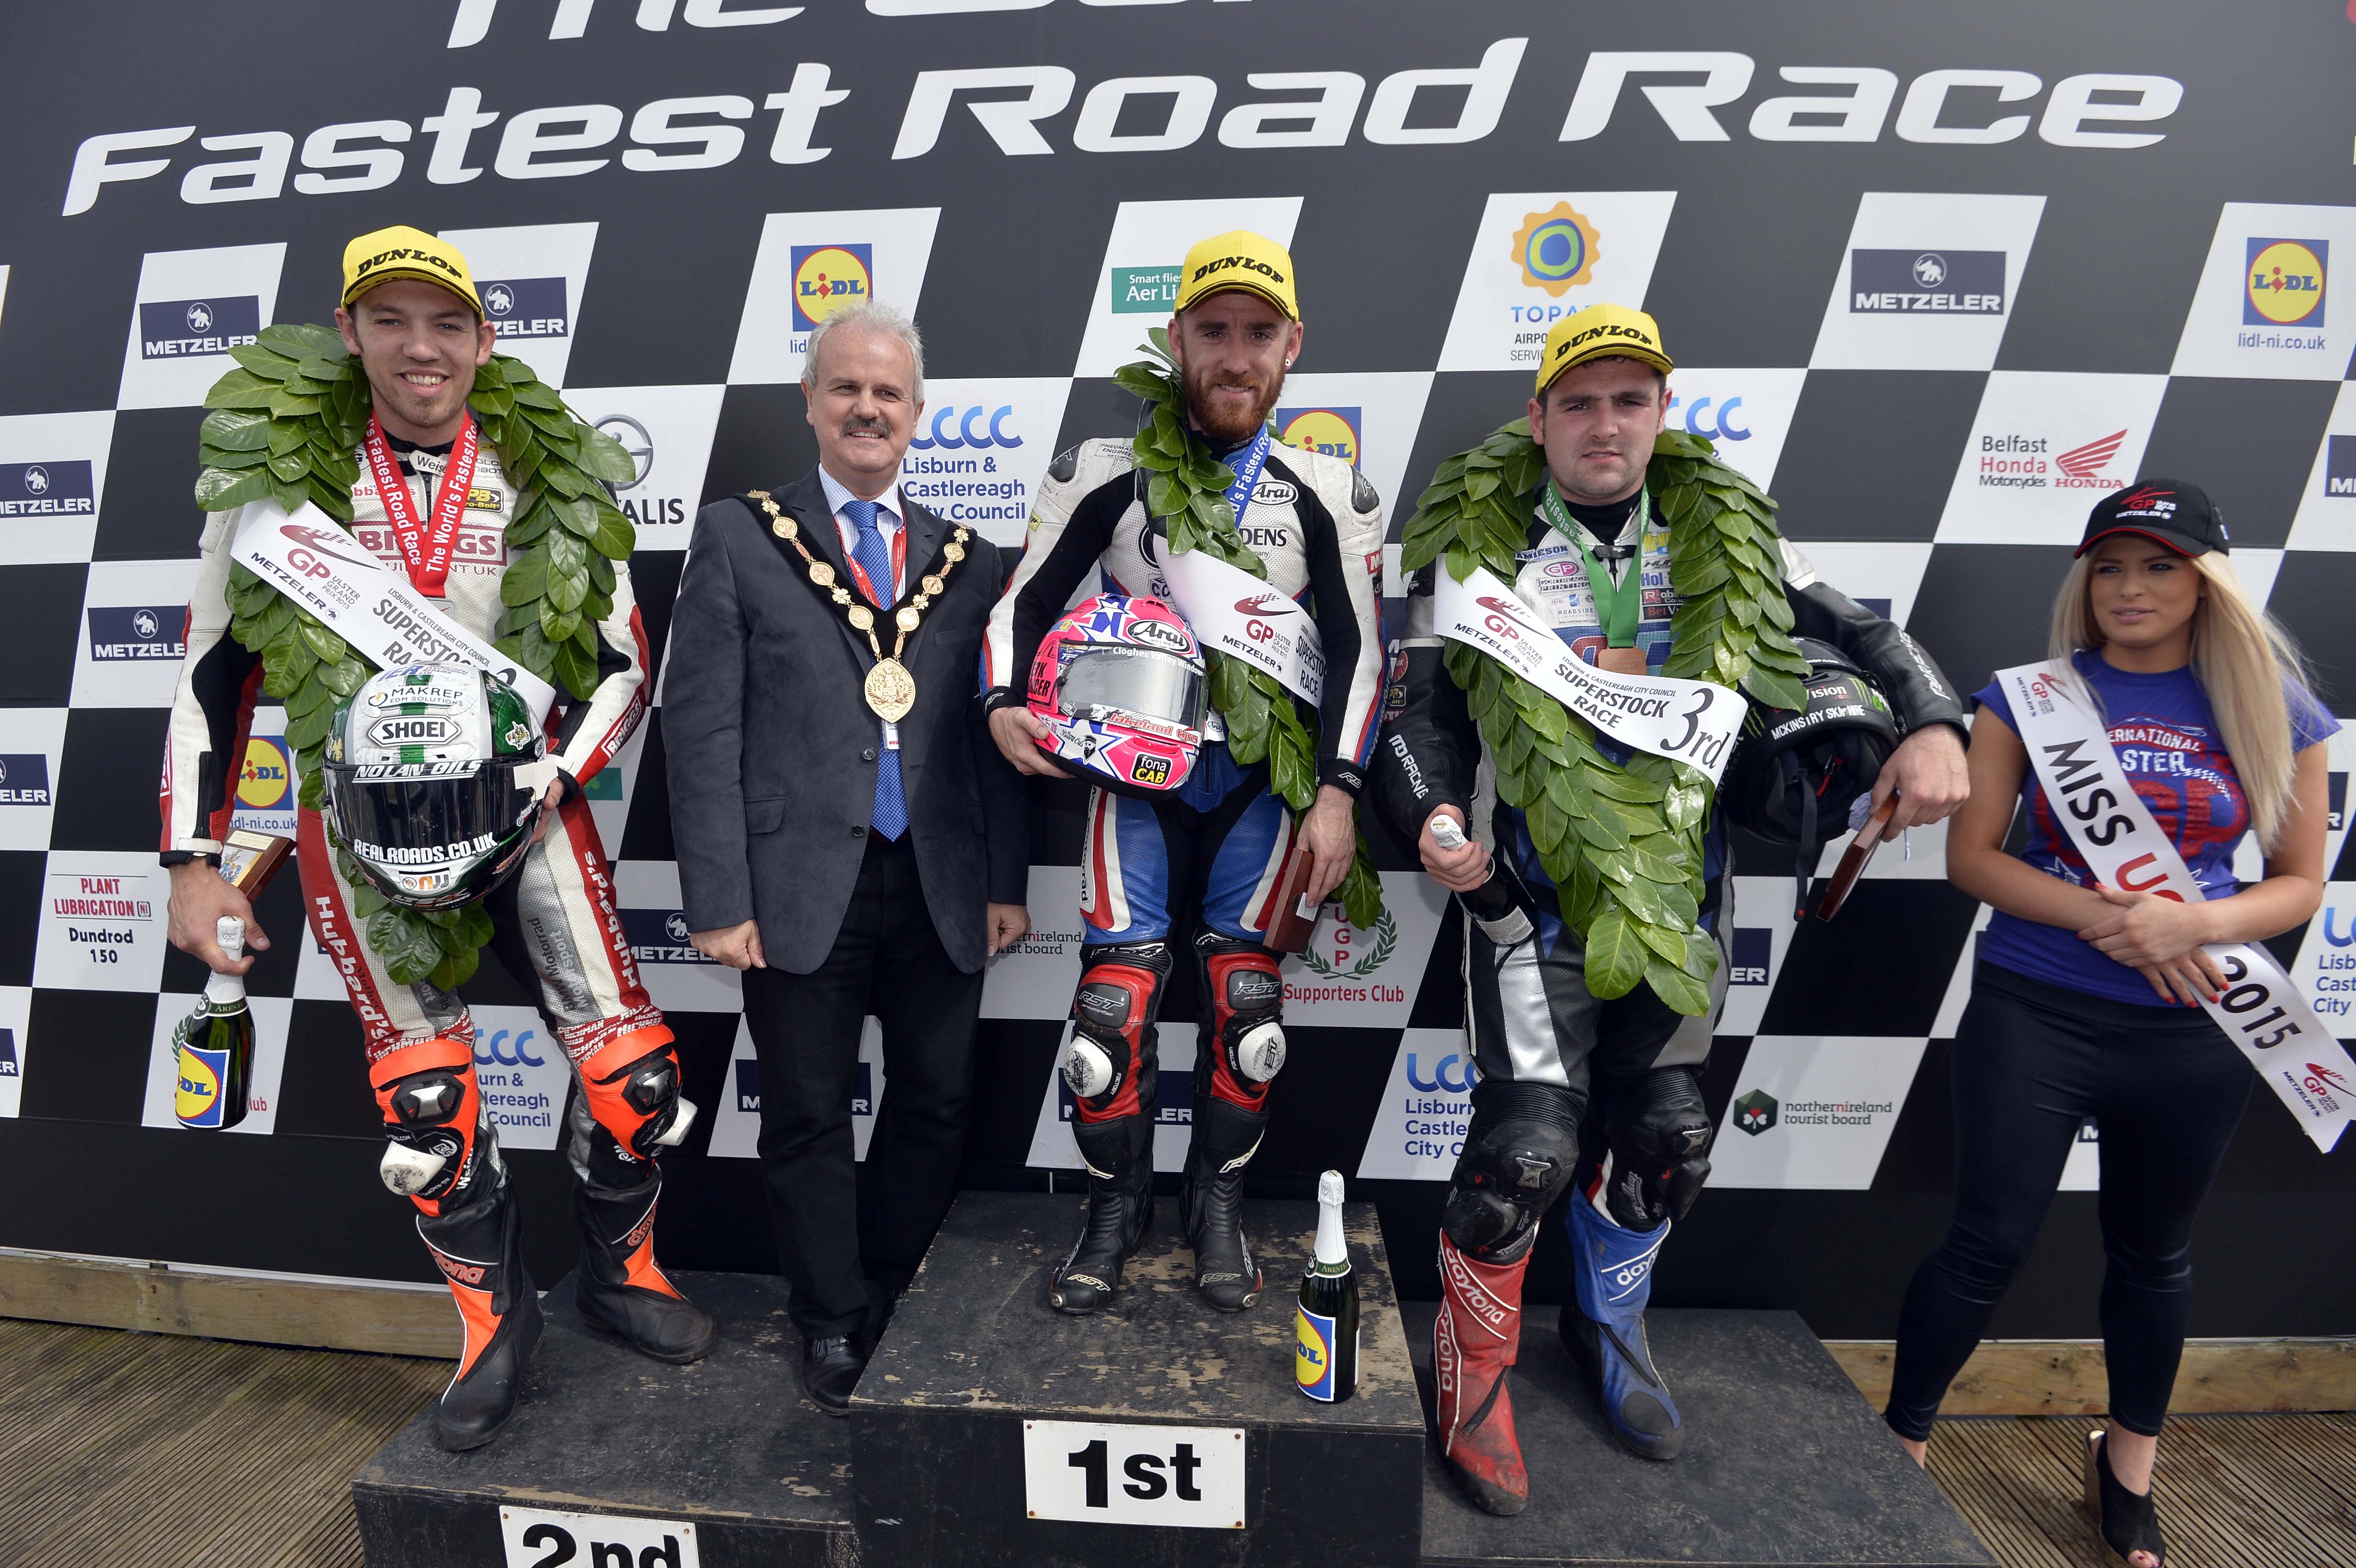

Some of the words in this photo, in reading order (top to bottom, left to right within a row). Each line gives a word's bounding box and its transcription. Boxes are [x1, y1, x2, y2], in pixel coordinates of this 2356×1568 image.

[62, 63, 850, 216] Fastest
[891, 37, 1529, 160] Road
[1558, 52, 2184, 149] Race
[357, 249, 462, 279] DUNLOP
[1192, 256, 1284, 283] DUNLOP
[1129, 274, 1160, 283] Smart
[1126, 286, 1158, 302] Aer
[1855, 292, 2001, 312] METZELER
[494, 318, 565, 336] ZELER
[146, 335, 258, 356] METZELER
[1515, 333, 1547, 344] AIRPO
[1555, 326, 1652, 360] DUNLOP
[2238, 333, 2325, 350] lidl-ni.co.uk
[1982, 436, 2048, 454] Belfast
[448, 441, 476, 492] Fastest
[903, 457, 977, 474] Lisburn
[983, 456, 997, 473] &
[1236, 446, 1264, 491] Fastest
[1980, 456, 2047, 474] Honda
[904, 479, 1025, 499] Castlereagh
[1979, 475, 2046, 489] Motorcycles
[2055, 479, 2126, 490] HONDA
[1252, 486, 1292, 498] Arai
[368, 437, 399, 490] Fastest
[386, 491, 414, 529] Road
[402, 531, 422, 566] Race
[2129, 500, 2156, 510] GP
[432, 492, 461, 547] World's
[950, 502, 1025, 520] Council
[426, 547, 446, 573] The
[1514, 545, 1569, 559] AMIESON
[287, 548, 330, 579] GP
[474, 566, 497, 575] UK
[1549, 564, 1574, 574] GP
[251, 552, 326, 610] METZELER
[332, 575, 360, 600] ULSTER
[1541, 582, 1591, 591] PRINTING
[321, 585, 338, 599] PRIX
[335, 597, 350, 610] 2015
[327, 581, 355, 605] GRAND
[388, 588, 413, 610] LISBURN
[417, 612, 457, 644] CASTLEREAGH
[455, 640, 470, 652] CITY
[468, 649, 491, 667] COUNCIL
[1133, 622, 1185, 646] Arai
[1246, 619, 1274, 644] GP
[1485, 614, 1519, 640] GP
[1151, 639, 1176, 647] HELMET
[1273, 639, 1290, 653] GRAND
[1275, 632, 1291, 647] ULSTER
[1454, 623, 1521, 665] METZELER
[96, 643, 186, 658] METZELE
[1113, 645, 1149, 659] Clogher
[1151, 650, 1176, 666] Valley
[1222, 635, 1276, 668] METZELER
[1271, 645, 1280, 655] PRIX
[1515, 645, 1527, 658] PRIX
[1525, 655, 1538, 667] 2015
[1517, 642, 1540, 664] GRAND
[1521, 638, 1544, 662] ULSTER
[1299, 669, 1318, 698] RACE
[1562, 656, 1585, 675] LISBURN
[1591, 675, 1633, 692] CASTLEREAGH
[1633, 686, 1649, 694] CITY
[1649, 687, 1676, 697] COUNCIL
[392, 686, 463, 699] MAKREP
[2016, 676, 2034, 702] METZELER
[2031, 681, 2048, 699] GP
[411, 697, 463, 707] SOLUTIONS
[1847, 705, 1865, 716] HIRE
[1554, 664, 1671, 718] SUPERSTOCK
[1660, 687, 1731, 769] 3rd
[1573, 695, 1623, 729] RACE
[382, 721, 445, 739] SHOEI
[606, 701, 641, 754] BRIGGS
[1110, 712, 1172, 736] lakeland
[1176, 729, 1199, 744] tyres
[355, 763, 425, 778] NOLAN
[431, 760, 483, 773] OILS
[1141, 755, 1167, 772] fona
[1135, 769, 1165, 784] CAB
[0, 790, 47, 803] ELER
[2042, 739, 2136, 847] MISS
[230, 817, 297, 829] idl-ni.co.uk
[354, 831, 499, 864] REALROADS.CO.UK
[81, 878, 120, 894] PLANT
[54, 898, 135, 916] LUBRICATION
[69, 927, 134, 944] Dundrod
[90, 949, 118, 963] 150
[527, 916, 560, 980] Motorrad
[1025, 943, 1063, 955] board
[316, 896, 392, 1040] Hubbard's
[1234, 981, 1280, 995] RST
[1284, 983, 1366, 1004] Supporters
[1372, 985, 1404, 1002] Club
[1079, 991, 1124, 1009] RST
[2208, 955, 2302, 1049] 2015
[2313, 998, 2351, 1015] City
[512, 1073, 524, 1087] &
[1110, 1072, 1122, 1095] FACTORY
[2304, 1076, 2327, 1097] GP
[2283, 1070, 2316, 1111] METZELER
[1786, 1100, 1893, 1114] northernireland
[487, 1111, 551, 1127] Council
[1784, 1113, 1830, 1125] tourist
[1832, 1113, 1872, 1126] board
[1405, 1141, 1445, 1159] City
[1067, 1273, 1111, 1291] RST
[1200, 1273, 1242, 1287] RST
[1446, 1246, 1507, 1326] daytona
[1068, 1438, 1203, 1510] 1st
